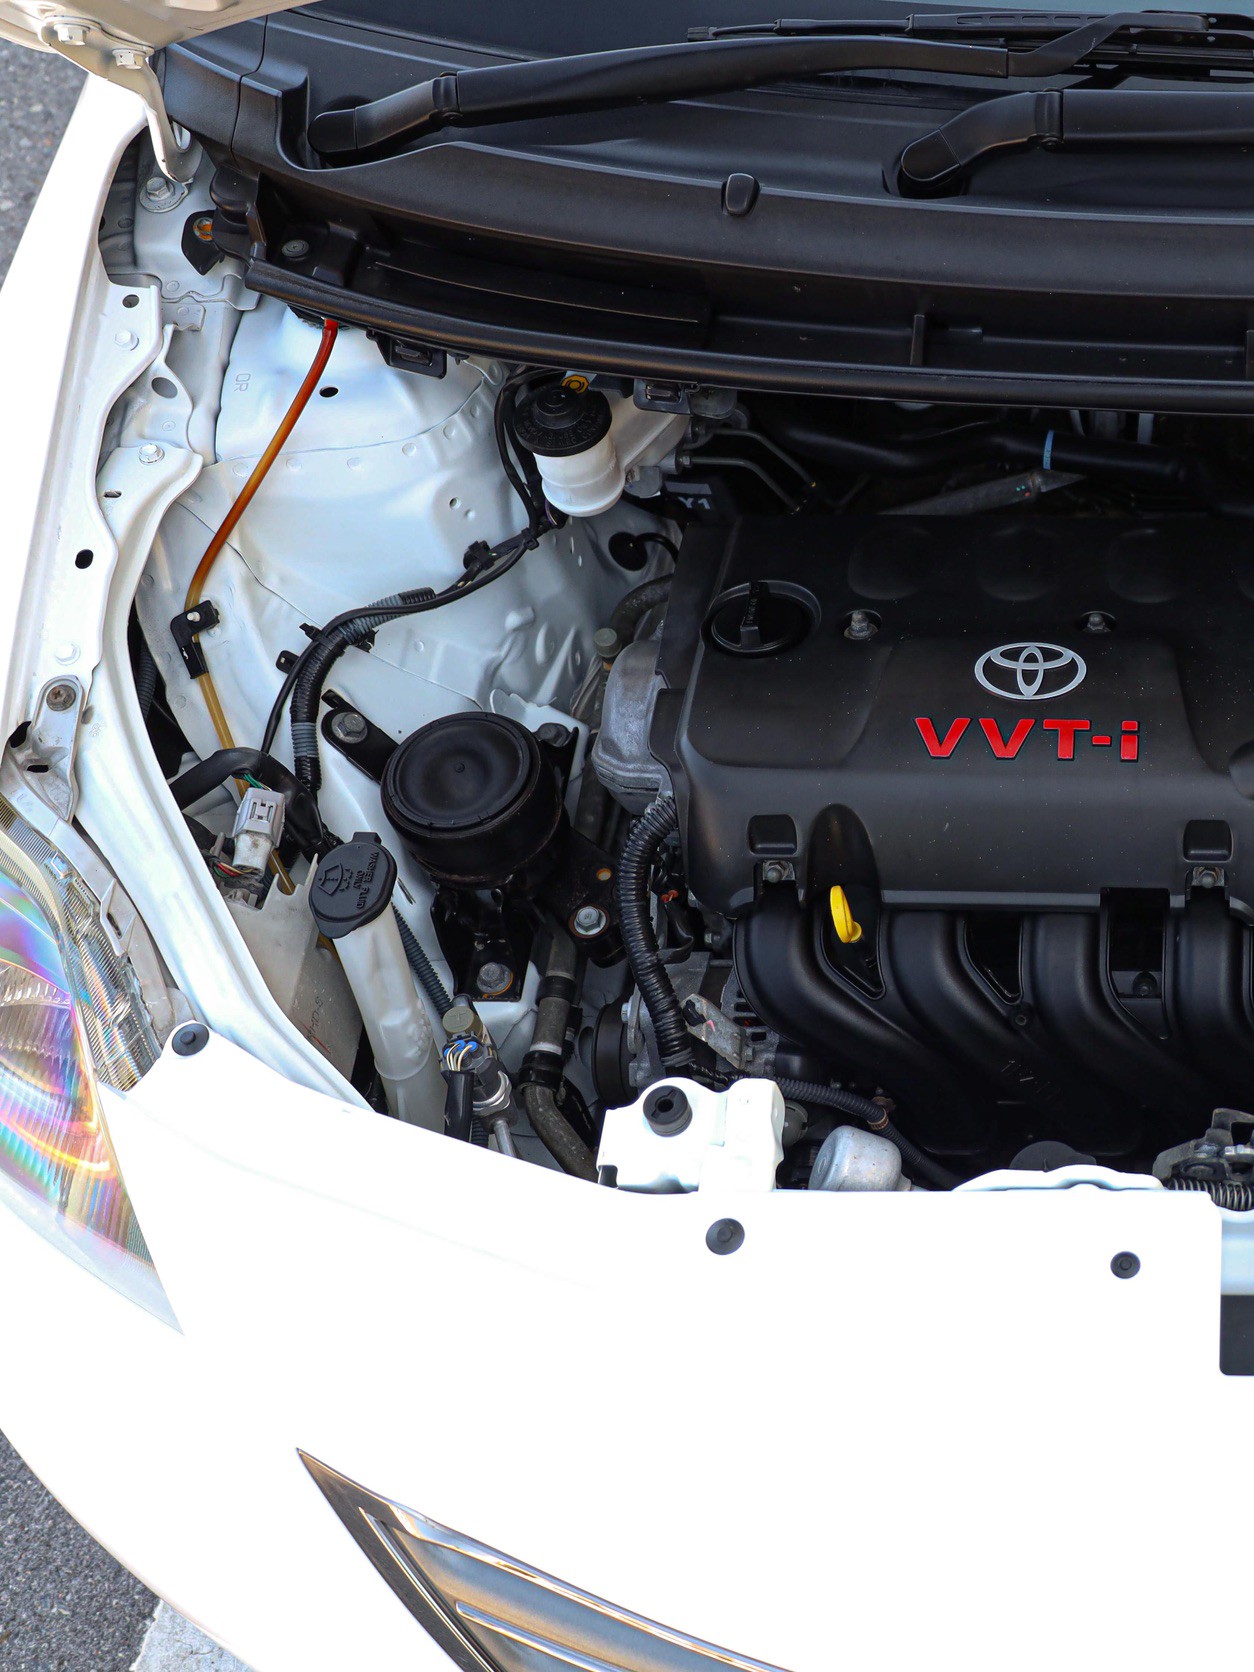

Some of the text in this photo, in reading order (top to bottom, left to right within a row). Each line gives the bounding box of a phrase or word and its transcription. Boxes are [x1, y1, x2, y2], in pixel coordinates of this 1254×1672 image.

[914, 717, 1140, 761] VVT-i
[353, 870, 365, 890] ONLY
[356, 852, 380, 909] WASHER FLUID
